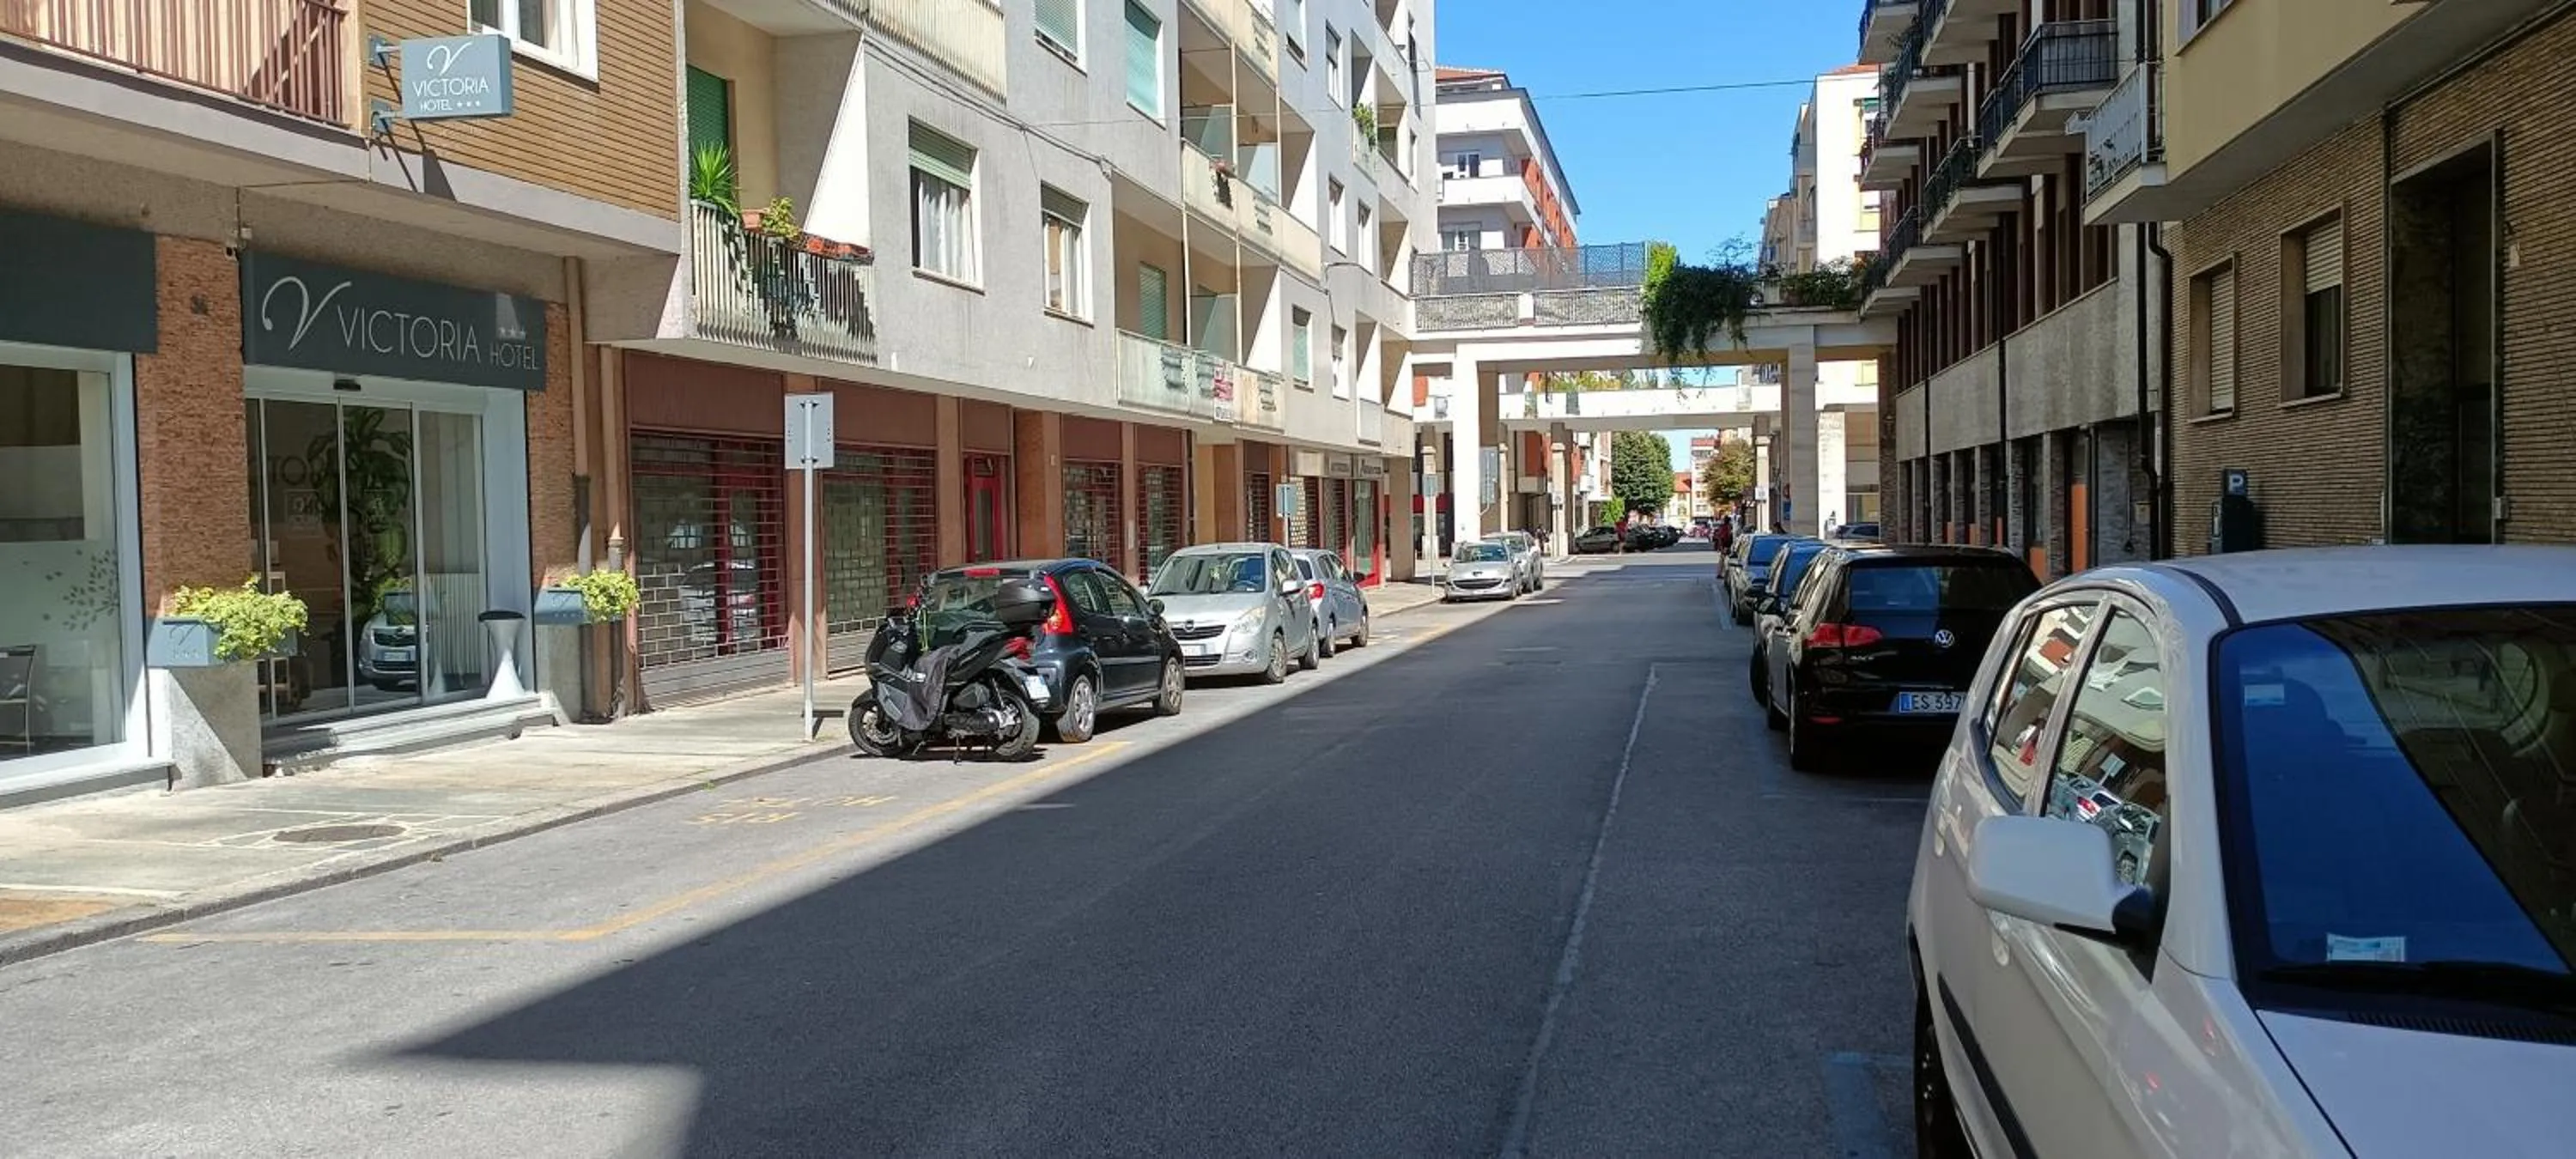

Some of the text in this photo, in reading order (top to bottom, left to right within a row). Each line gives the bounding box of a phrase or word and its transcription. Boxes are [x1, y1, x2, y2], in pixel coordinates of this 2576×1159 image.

[427, 40, 473, 76] V
[411, 76, 490, 98] VICTORIA
[419, 98, 453, 112] HOTEL
[261, 276, 539, 371] V VICTORIA HOTEL
[2227, 473, 2245, 492] P
